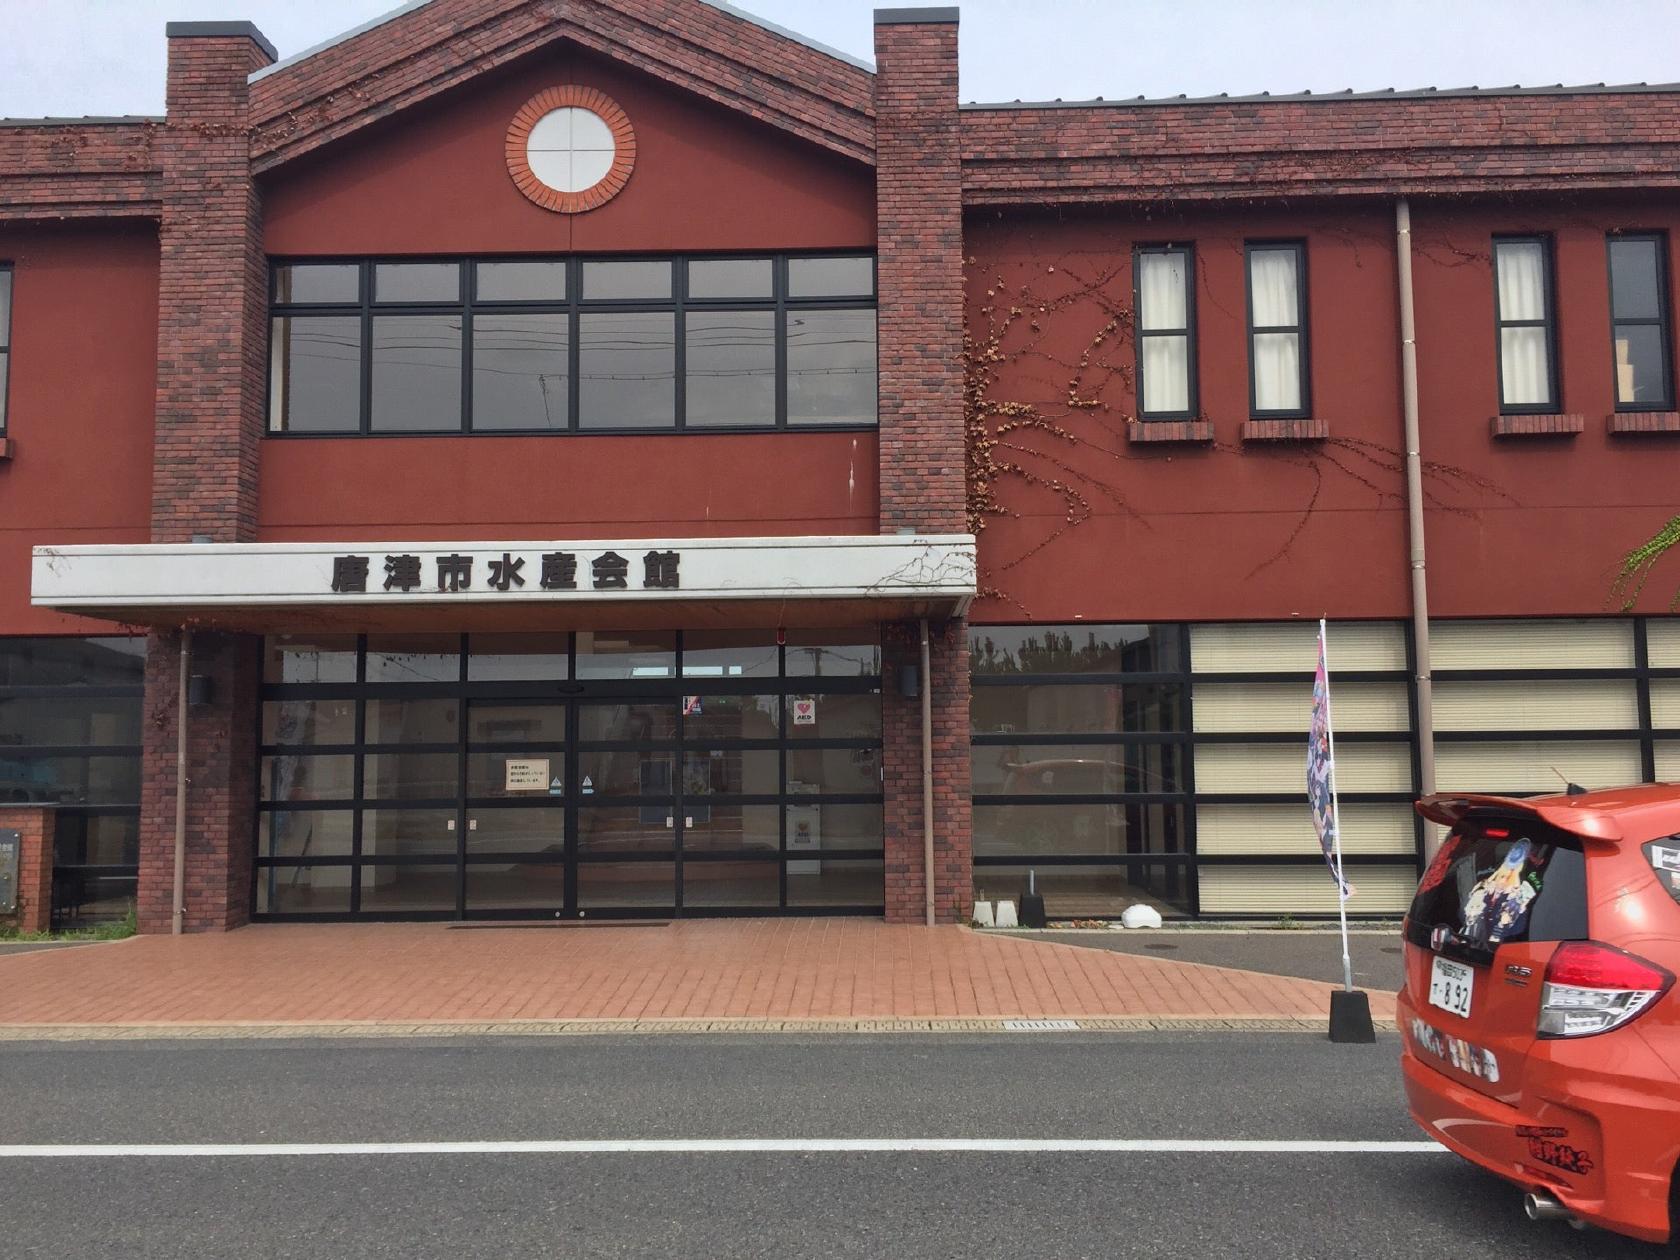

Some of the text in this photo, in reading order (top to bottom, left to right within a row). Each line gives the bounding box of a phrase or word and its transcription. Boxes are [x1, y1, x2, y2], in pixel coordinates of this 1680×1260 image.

[331, 550, 681, 593] 唐津市水産会館
